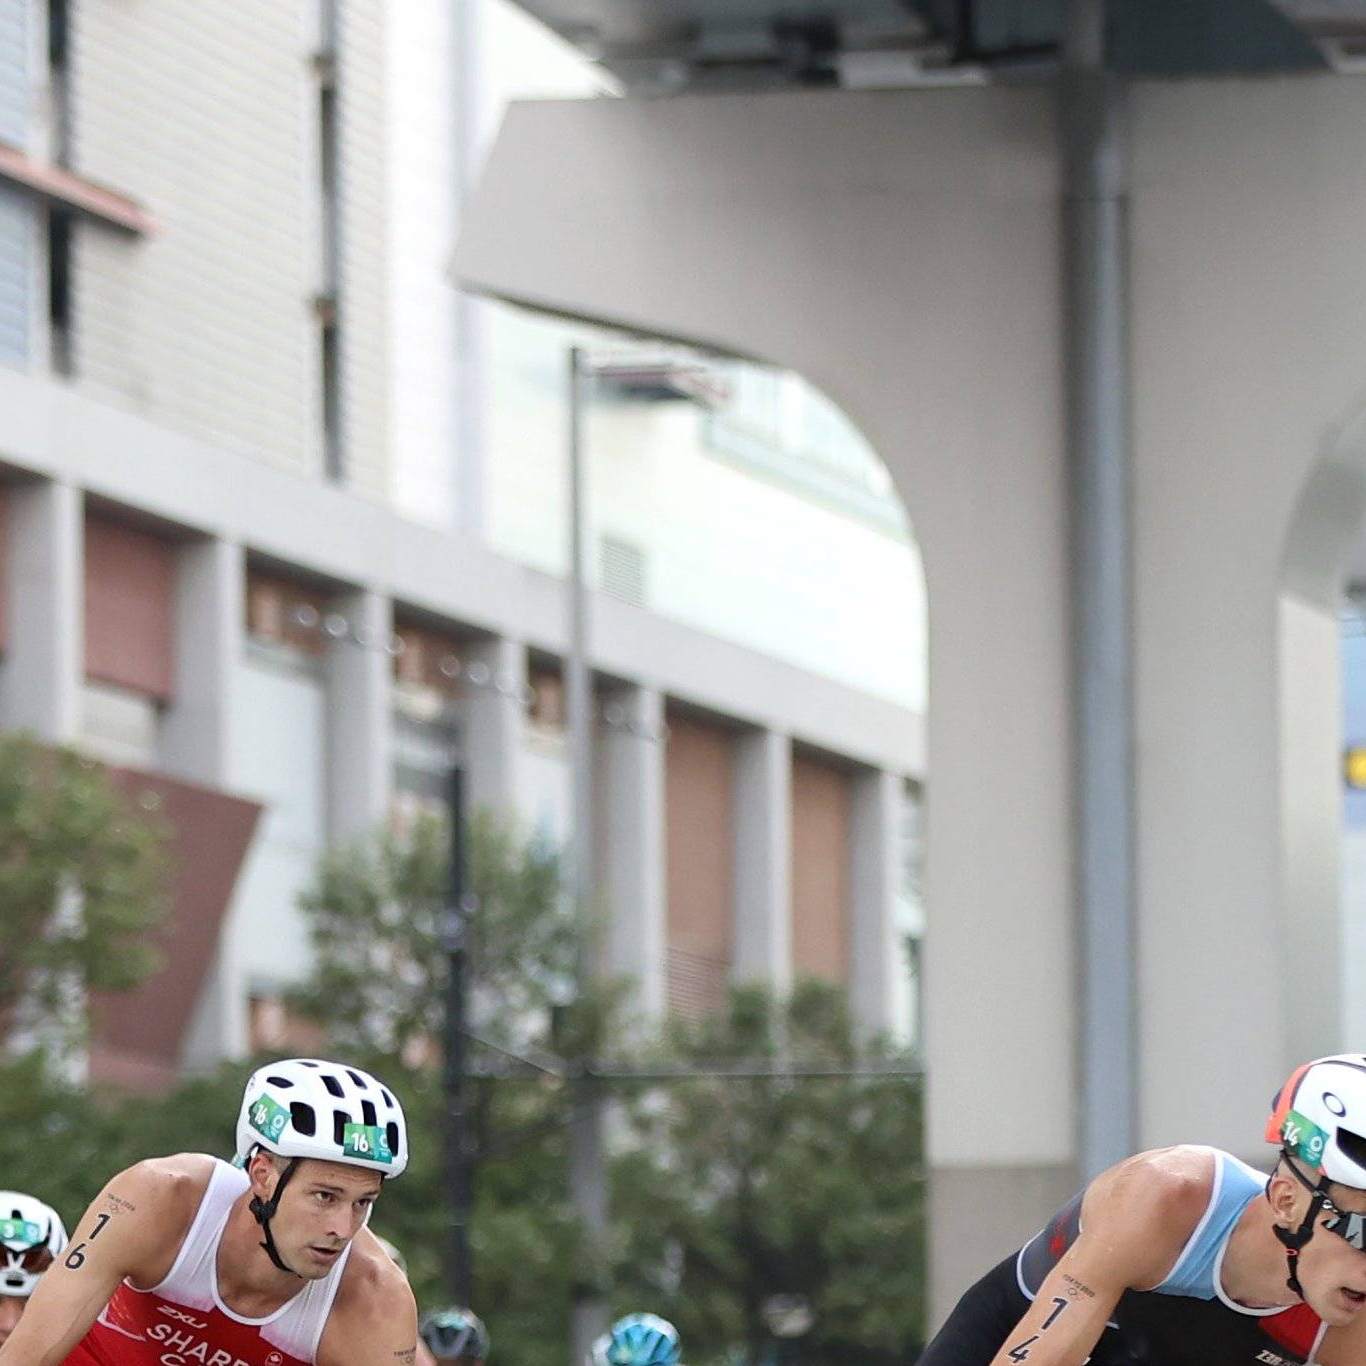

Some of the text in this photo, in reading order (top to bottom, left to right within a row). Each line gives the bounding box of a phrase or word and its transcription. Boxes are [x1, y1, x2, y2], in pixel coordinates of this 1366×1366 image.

[252, 1102, 269, 1125] 16
[350, 1131, 372, 1153] 16
[1282, 1120, 1302, 1147] 14
